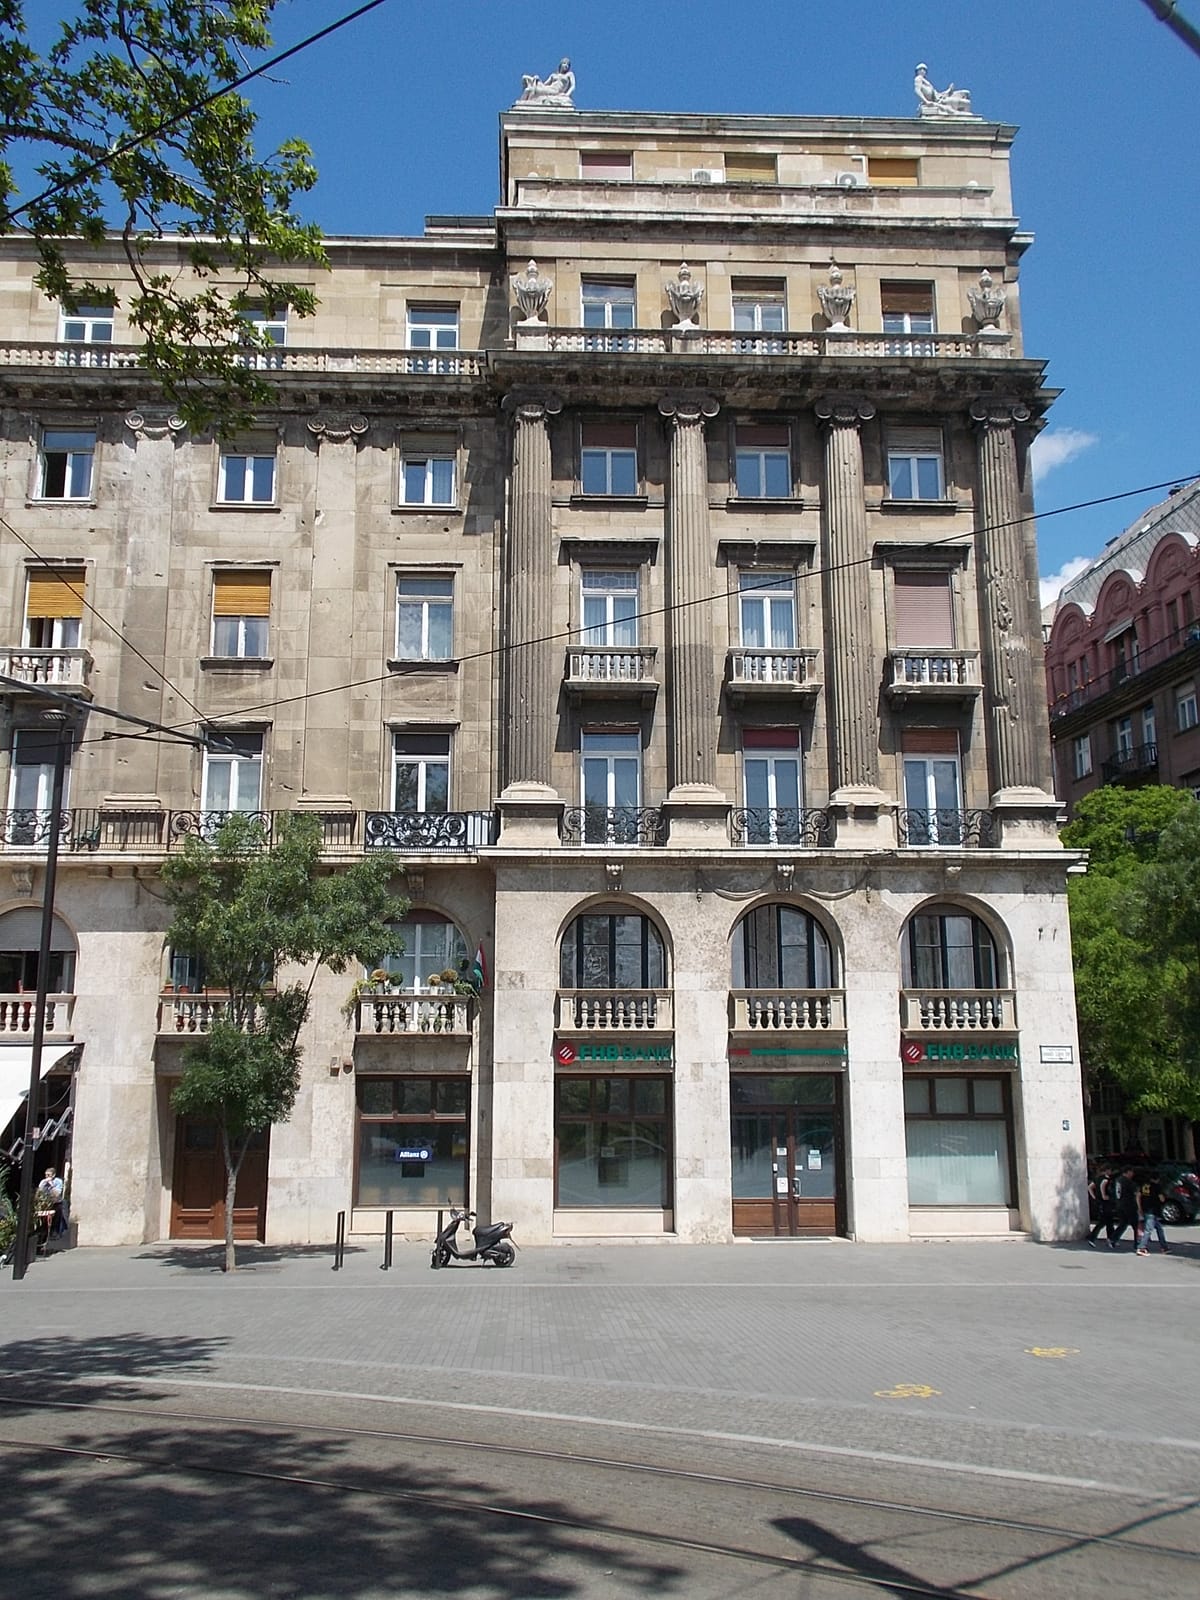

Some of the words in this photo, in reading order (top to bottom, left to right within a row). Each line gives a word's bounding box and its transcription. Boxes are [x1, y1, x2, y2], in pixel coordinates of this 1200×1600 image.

[579, 1044, 619, 1061] FHB
[622, 1045, 672, 1061] BANK
[926, 1044, 965, 1060] FHB
[967, 1044, 1016, 1060] BANK
